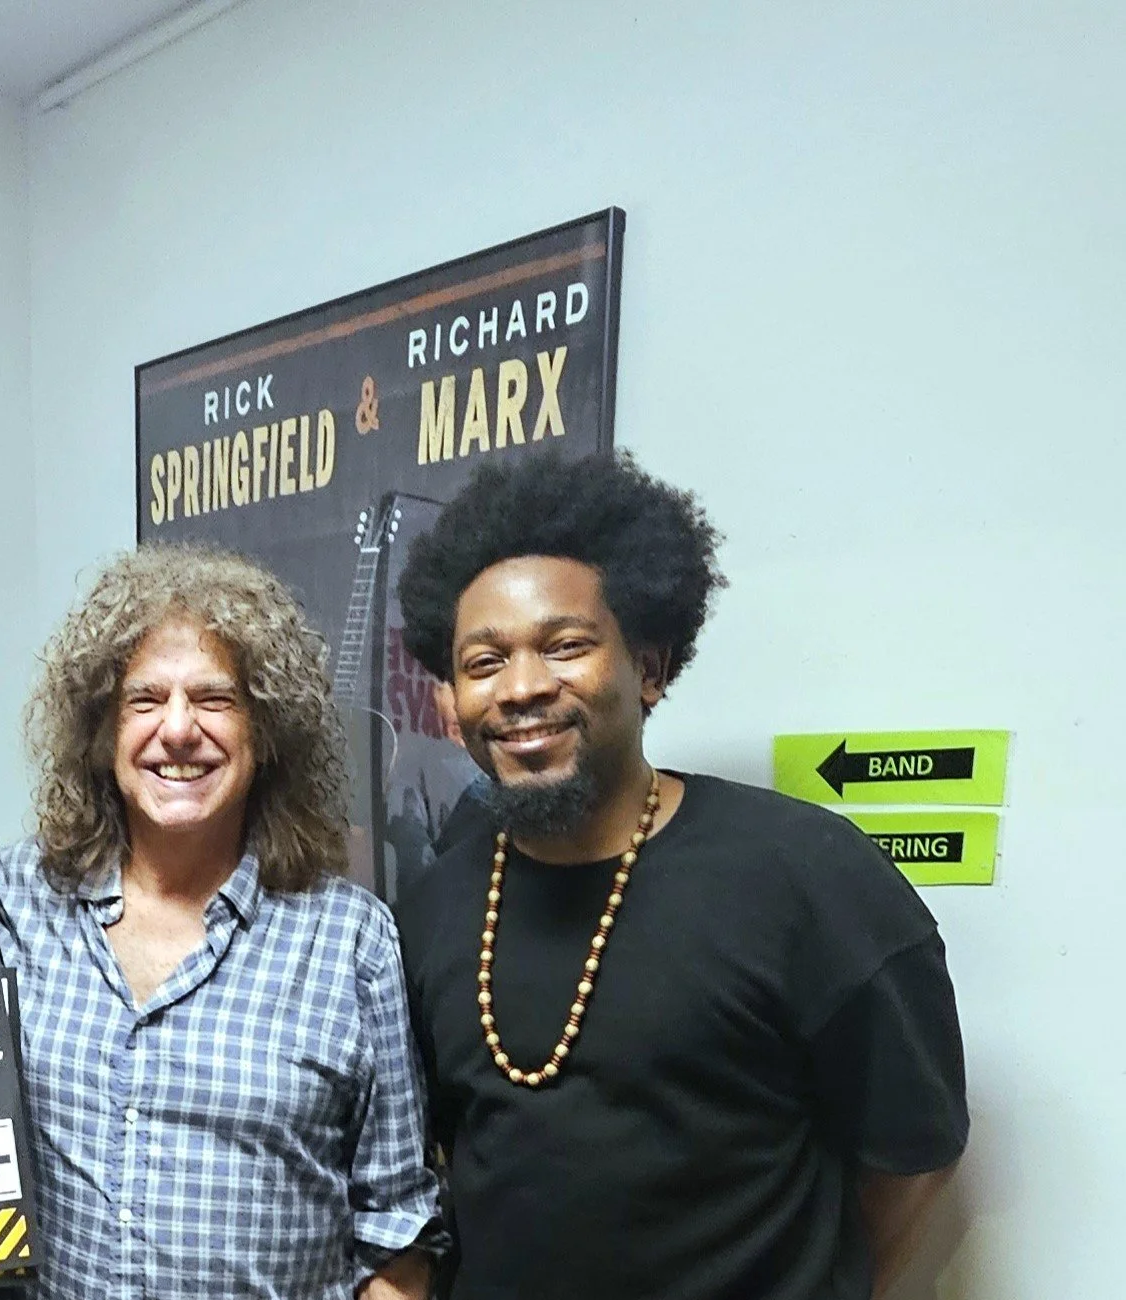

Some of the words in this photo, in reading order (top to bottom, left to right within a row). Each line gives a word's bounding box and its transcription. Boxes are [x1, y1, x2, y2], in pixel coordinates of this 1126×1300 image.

[407, 282, 590, 368] RICHARD
[204, 374, 274, 426] RICK
[356, 376, 380, 435] &
[417, 346, 569, 466] MARX
[150, 408, 335, 526] SPRINGFIELD
[868, 755, 934, 777] BAND
[873, 837, 949, 858] ERING
